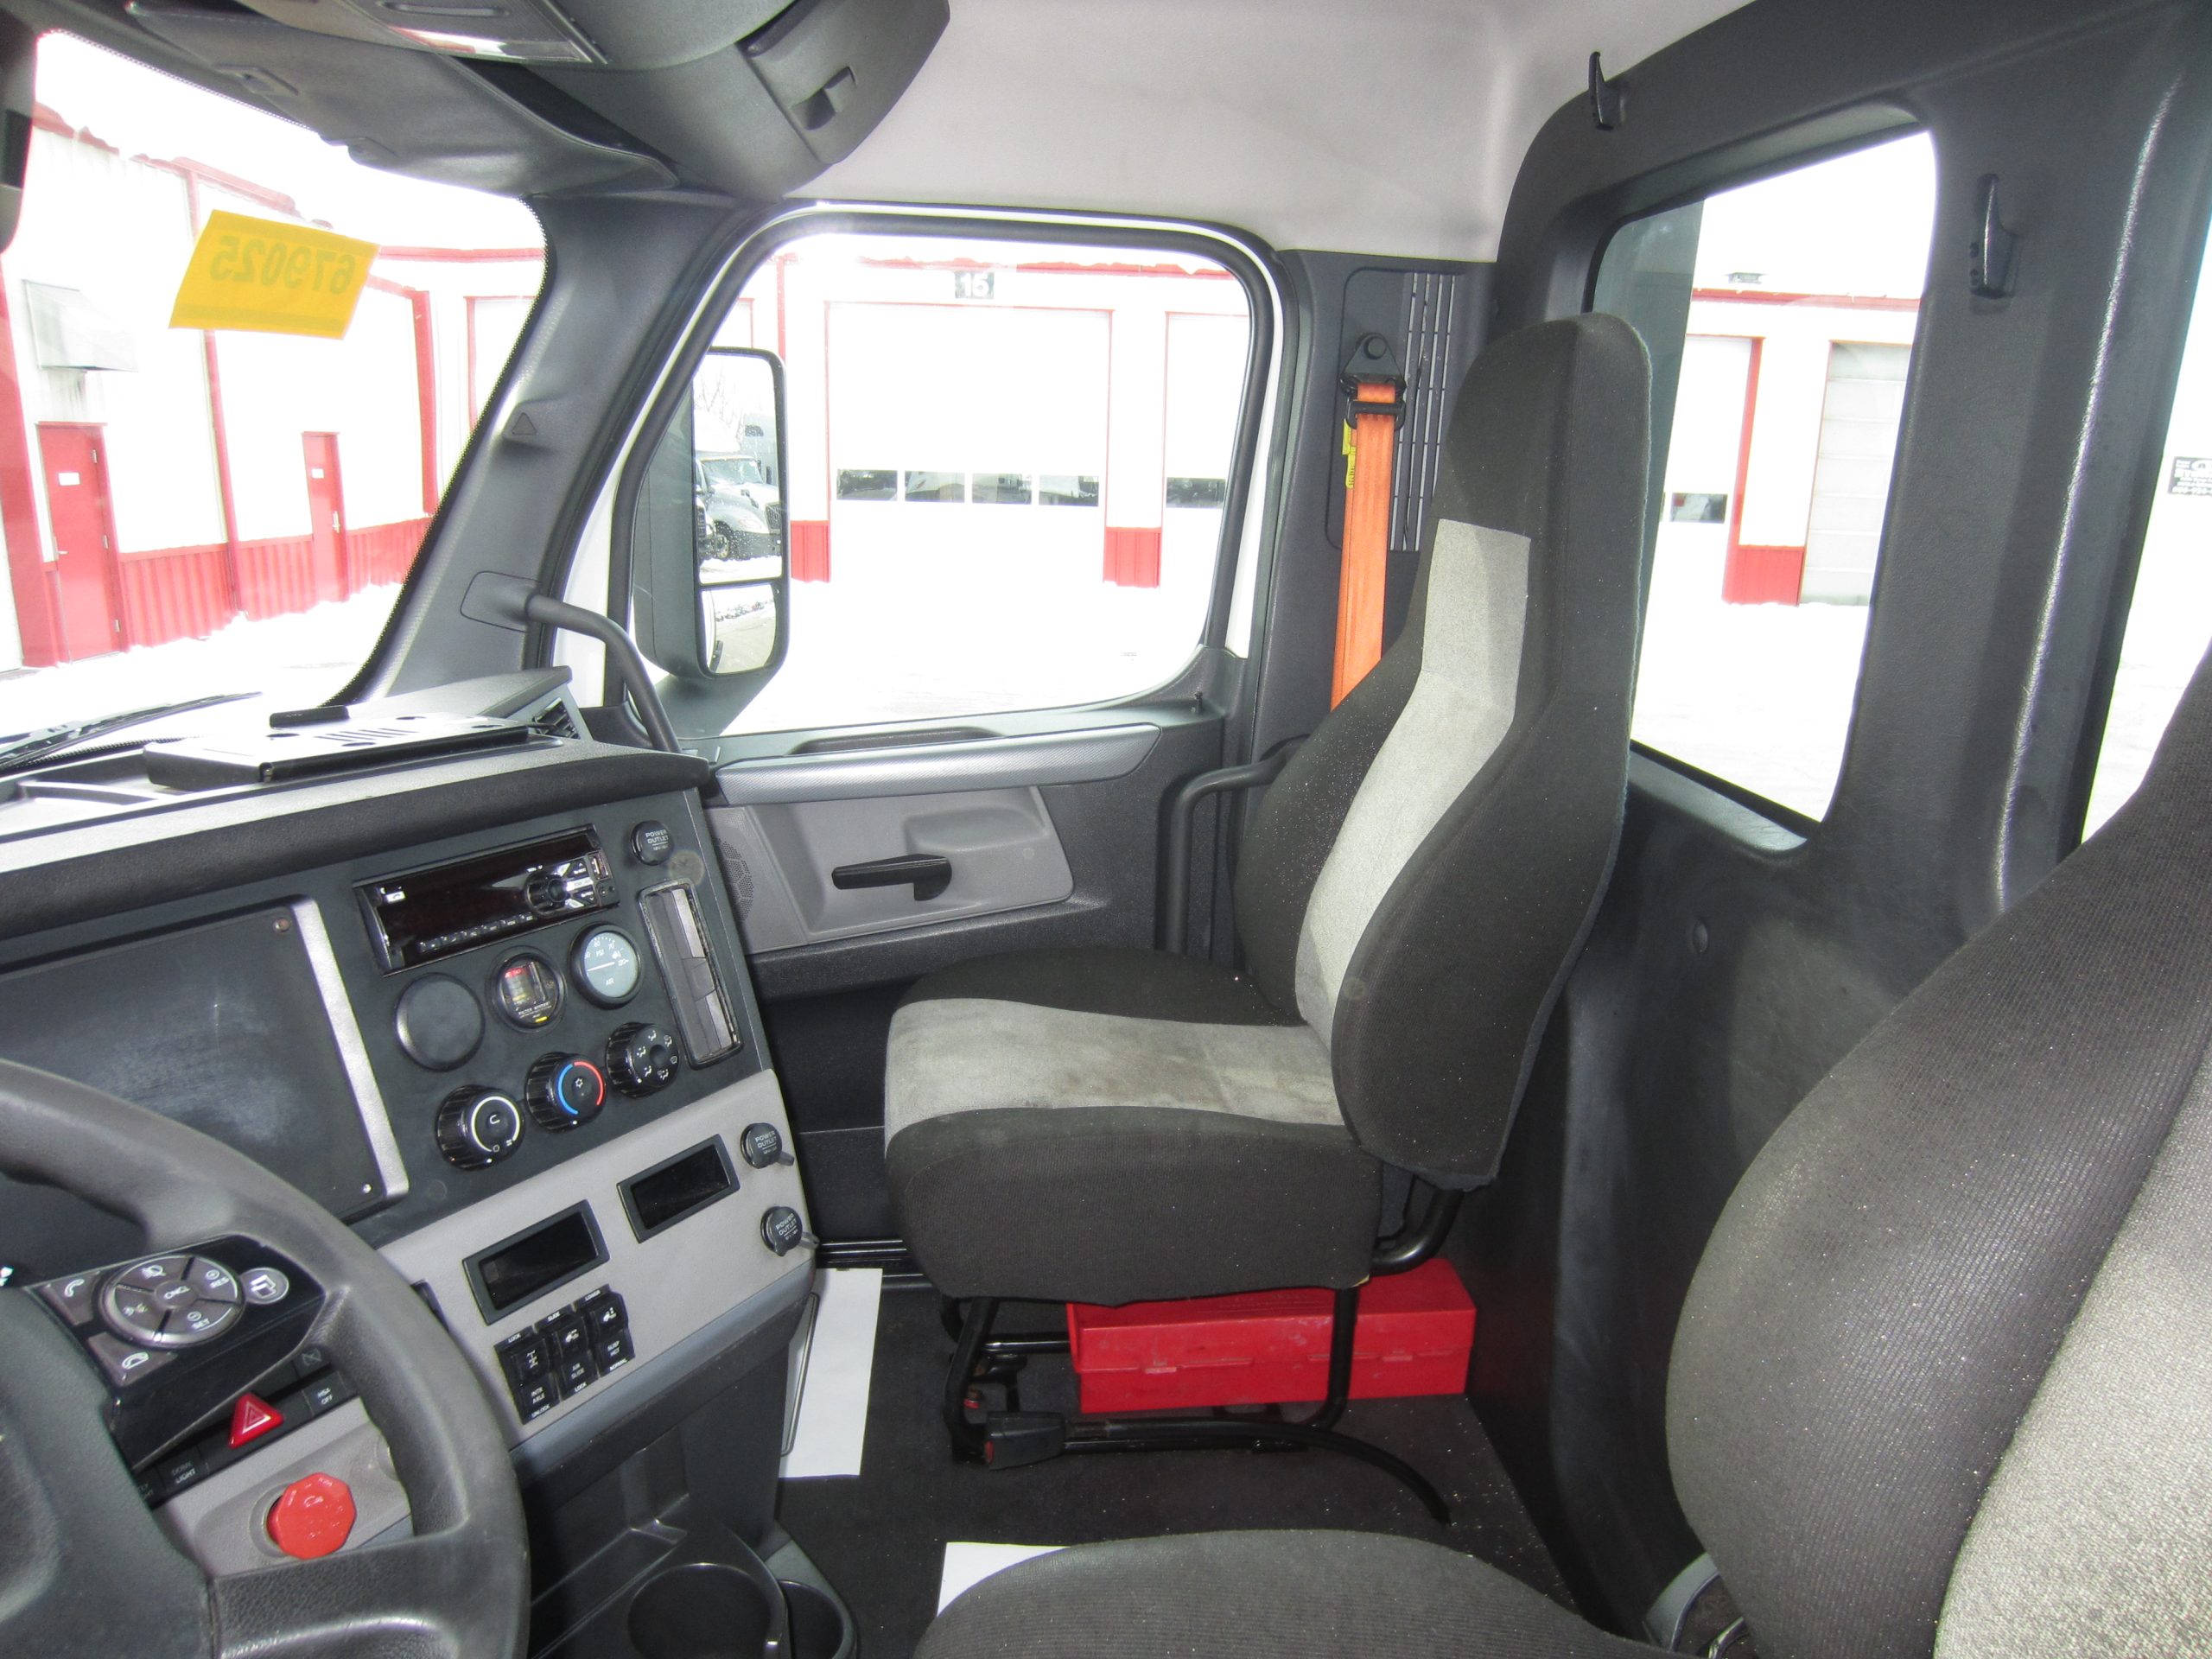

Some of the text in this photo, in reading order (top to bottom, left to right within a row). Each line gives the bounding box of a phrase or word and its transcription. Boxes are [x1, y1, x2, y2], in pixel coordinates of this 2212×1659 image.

[960, 272, 989, 296] 15
[645, 830, 667, 838] POWER
[647, 836, 669, 844] OUTLET
[755, 1130, 776, 1142] POWER
[757, 1136, 777, 1148] OUTLET
[775, 1212, 795, 1230] POWER
[779, 1218, 797, 1236] OUTLET
[508, 1332, 521, 1344] LOCK
[574, 1382, 587, 1392] LOCK
[531, 1404, 550, 1418] UNLOCK
[175, 1468, 196, 1484] LIGHT
